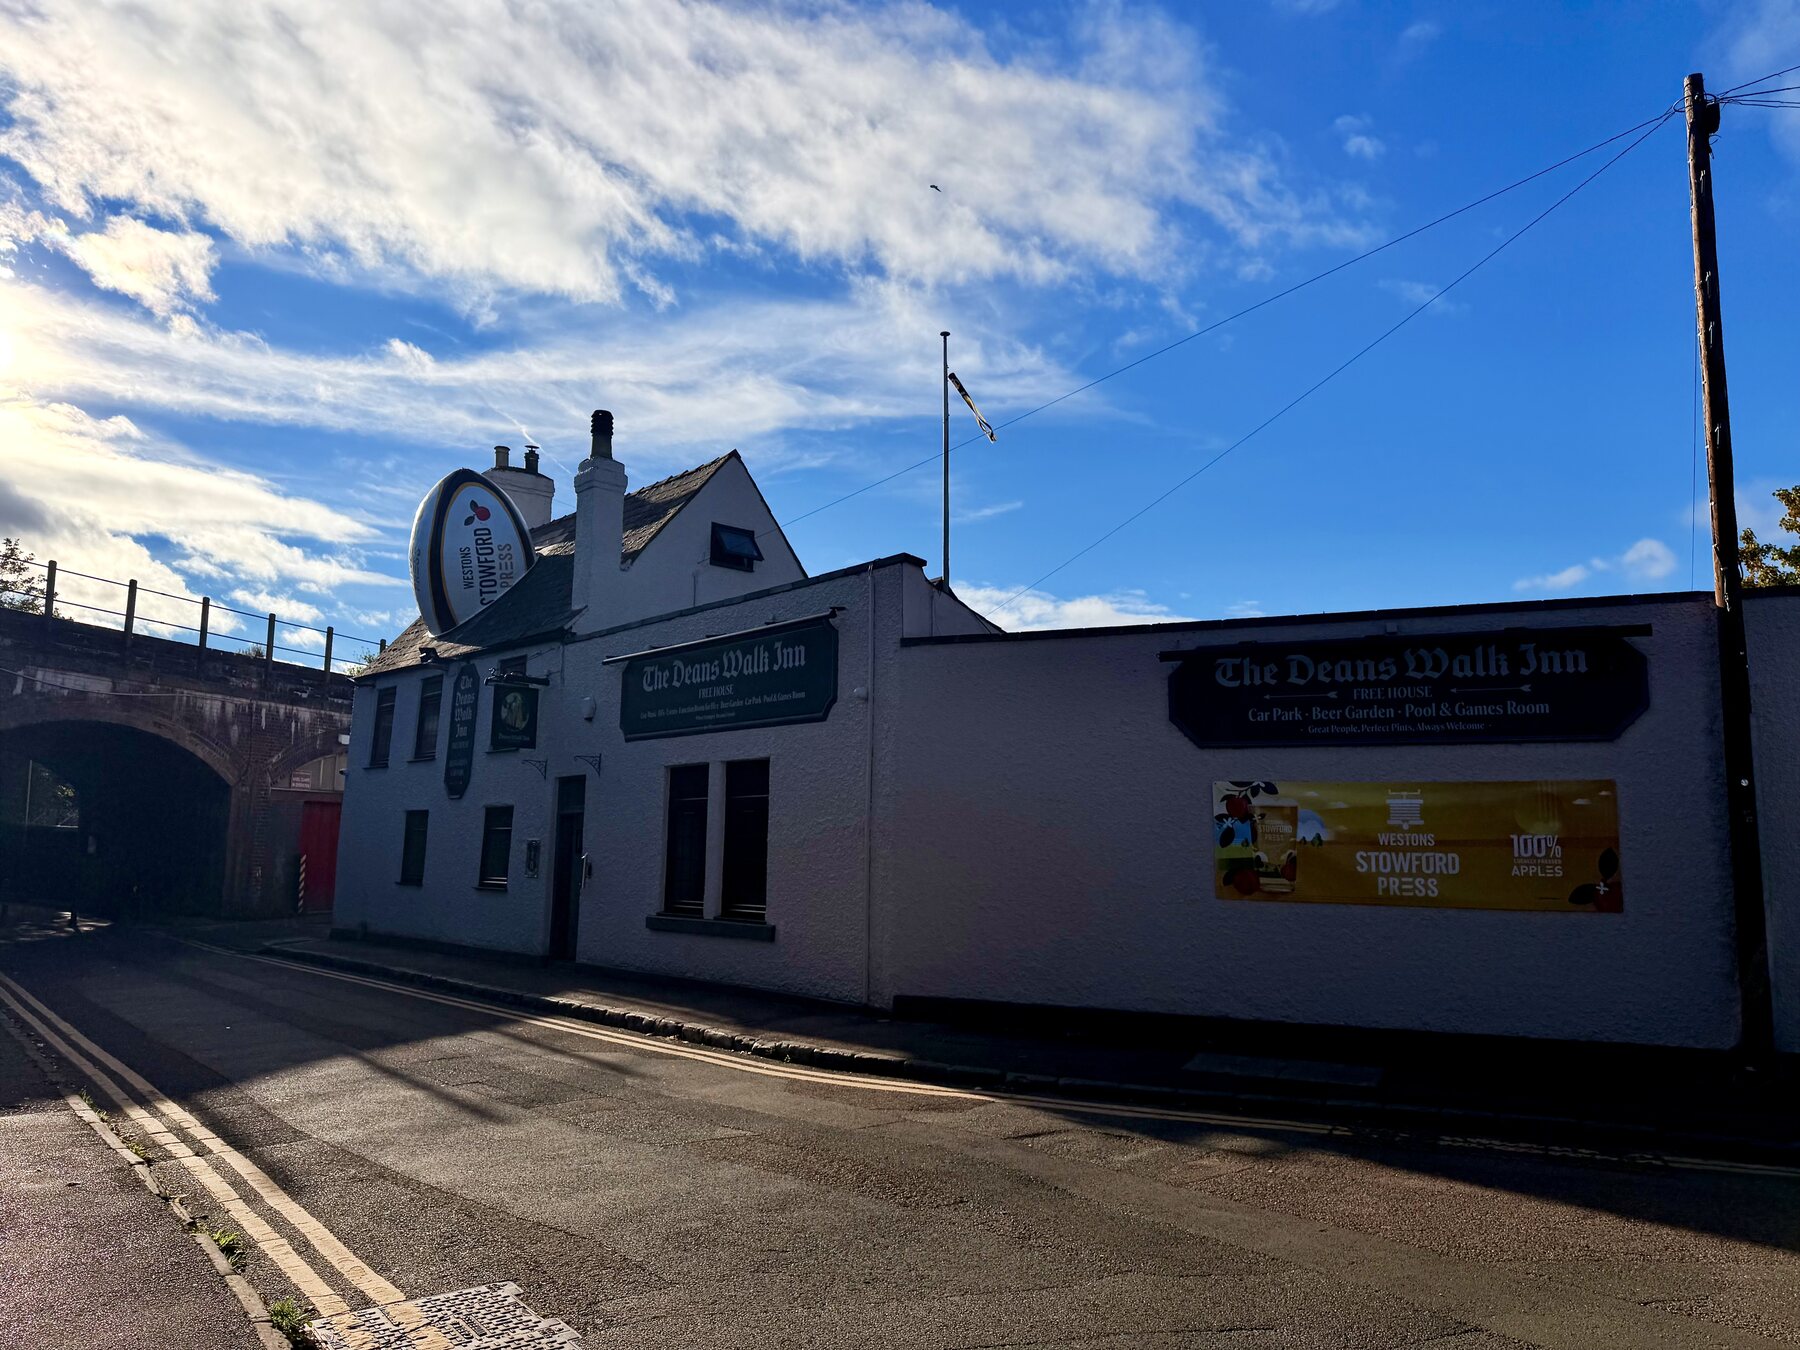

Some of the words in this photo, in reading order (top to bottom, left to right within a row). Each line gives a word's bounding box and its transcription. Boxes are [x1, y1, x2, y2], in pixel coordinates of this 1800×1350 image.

[459, 546, 474, 590] WESTONS
[474, 527, 497, 606] STOWFORD
[498, 543, 514, 589] PRESS
[641, 664, 670, 693] The
[672, 659, 720, 689] Deans
[721, 643, 770, 679] Walk
[772, 640, 807, 672] Inn
[1214, 656, 1279, 688] The
[1285, 654, 1398, 686] Deans
[1403, 643, 1511, 680] Walk
[1518, 642, 1589, 676] Inn
[698, 686, 715, 699] FREE
[715, 684, 734, 698] HOUSE
[1352, 687, 1386, 700] FREE
[1387, 686, 1433, 699] HOUSE
[1248, 707, 1270, 722] Car
[1272, 706, 1303, 722] Park
[1311, 705, 1342, 721] Beer
[1344, 704, 1395, 720] Garden
[1404, 702, 1437, 718] Pool
[1439, 702, 1453, 717] &
[1454, 701, 1504, 717] Games
[1506, 700, 1550, 715] Room
[1308, 724, 1330, 735] Great
[1446, 720, 1485, 731] Welcome
[1377, 832, 1436, 847] WESTONS
[1509, 833, 1563, 859] 100%
[1355, 850, 1461, 875] STOWFORD
[1510, 865, 1564, 878] APPLES
[1377, 876, 1439, 898] PRESS
